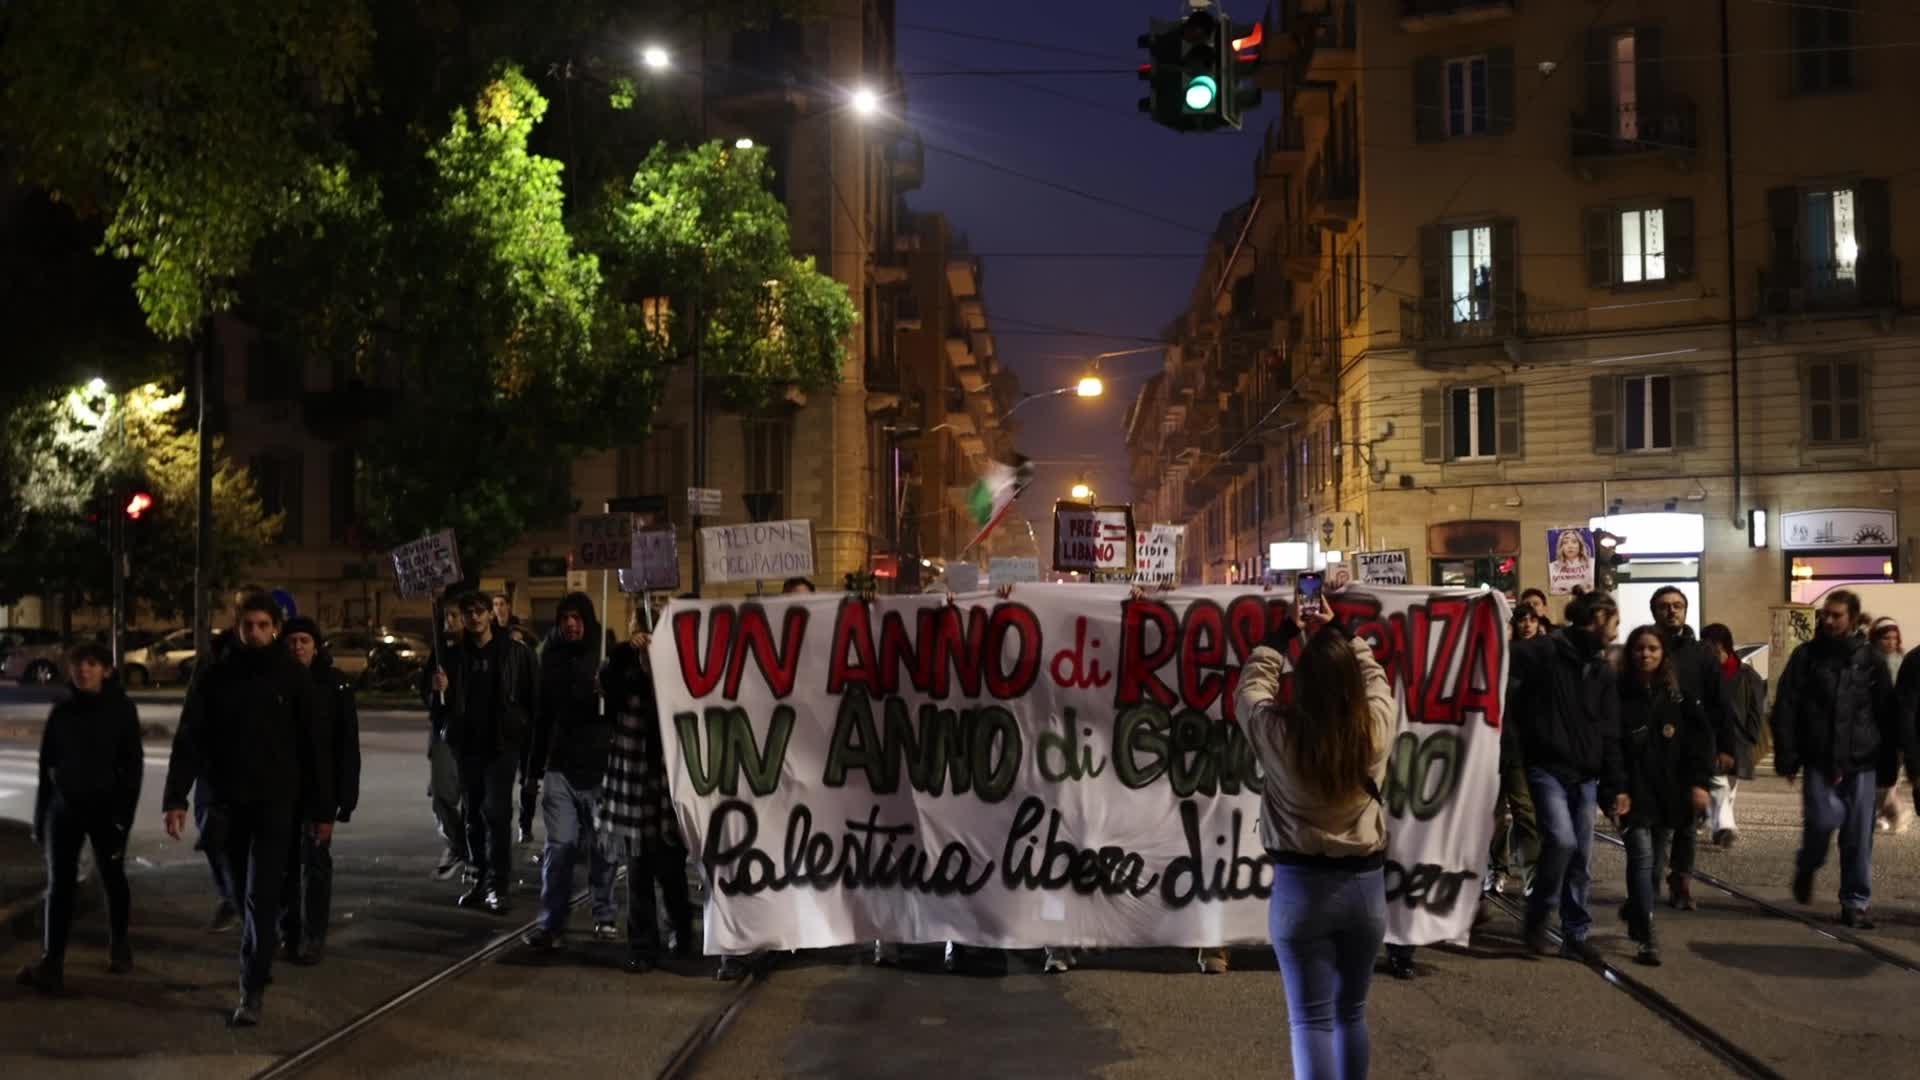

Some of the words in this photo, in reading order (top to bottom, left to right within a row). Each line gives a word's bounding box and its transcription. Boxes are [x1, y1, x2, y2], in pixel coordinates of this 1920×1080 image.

[1063, 542, 1114, 562] LIBANO
[673, 602, 809, 699] UN
[827, 596, 1042, 699] ANNO
[1051, 616, 1112, 689] di
[673, 704, 797, 797] UN
[823, 686, 1023, 801] ANNO
[1038, 706, 1106, 782] di
[704, 800, 995, 897] Palestina
[1001, 796, 1158, 898] libera
